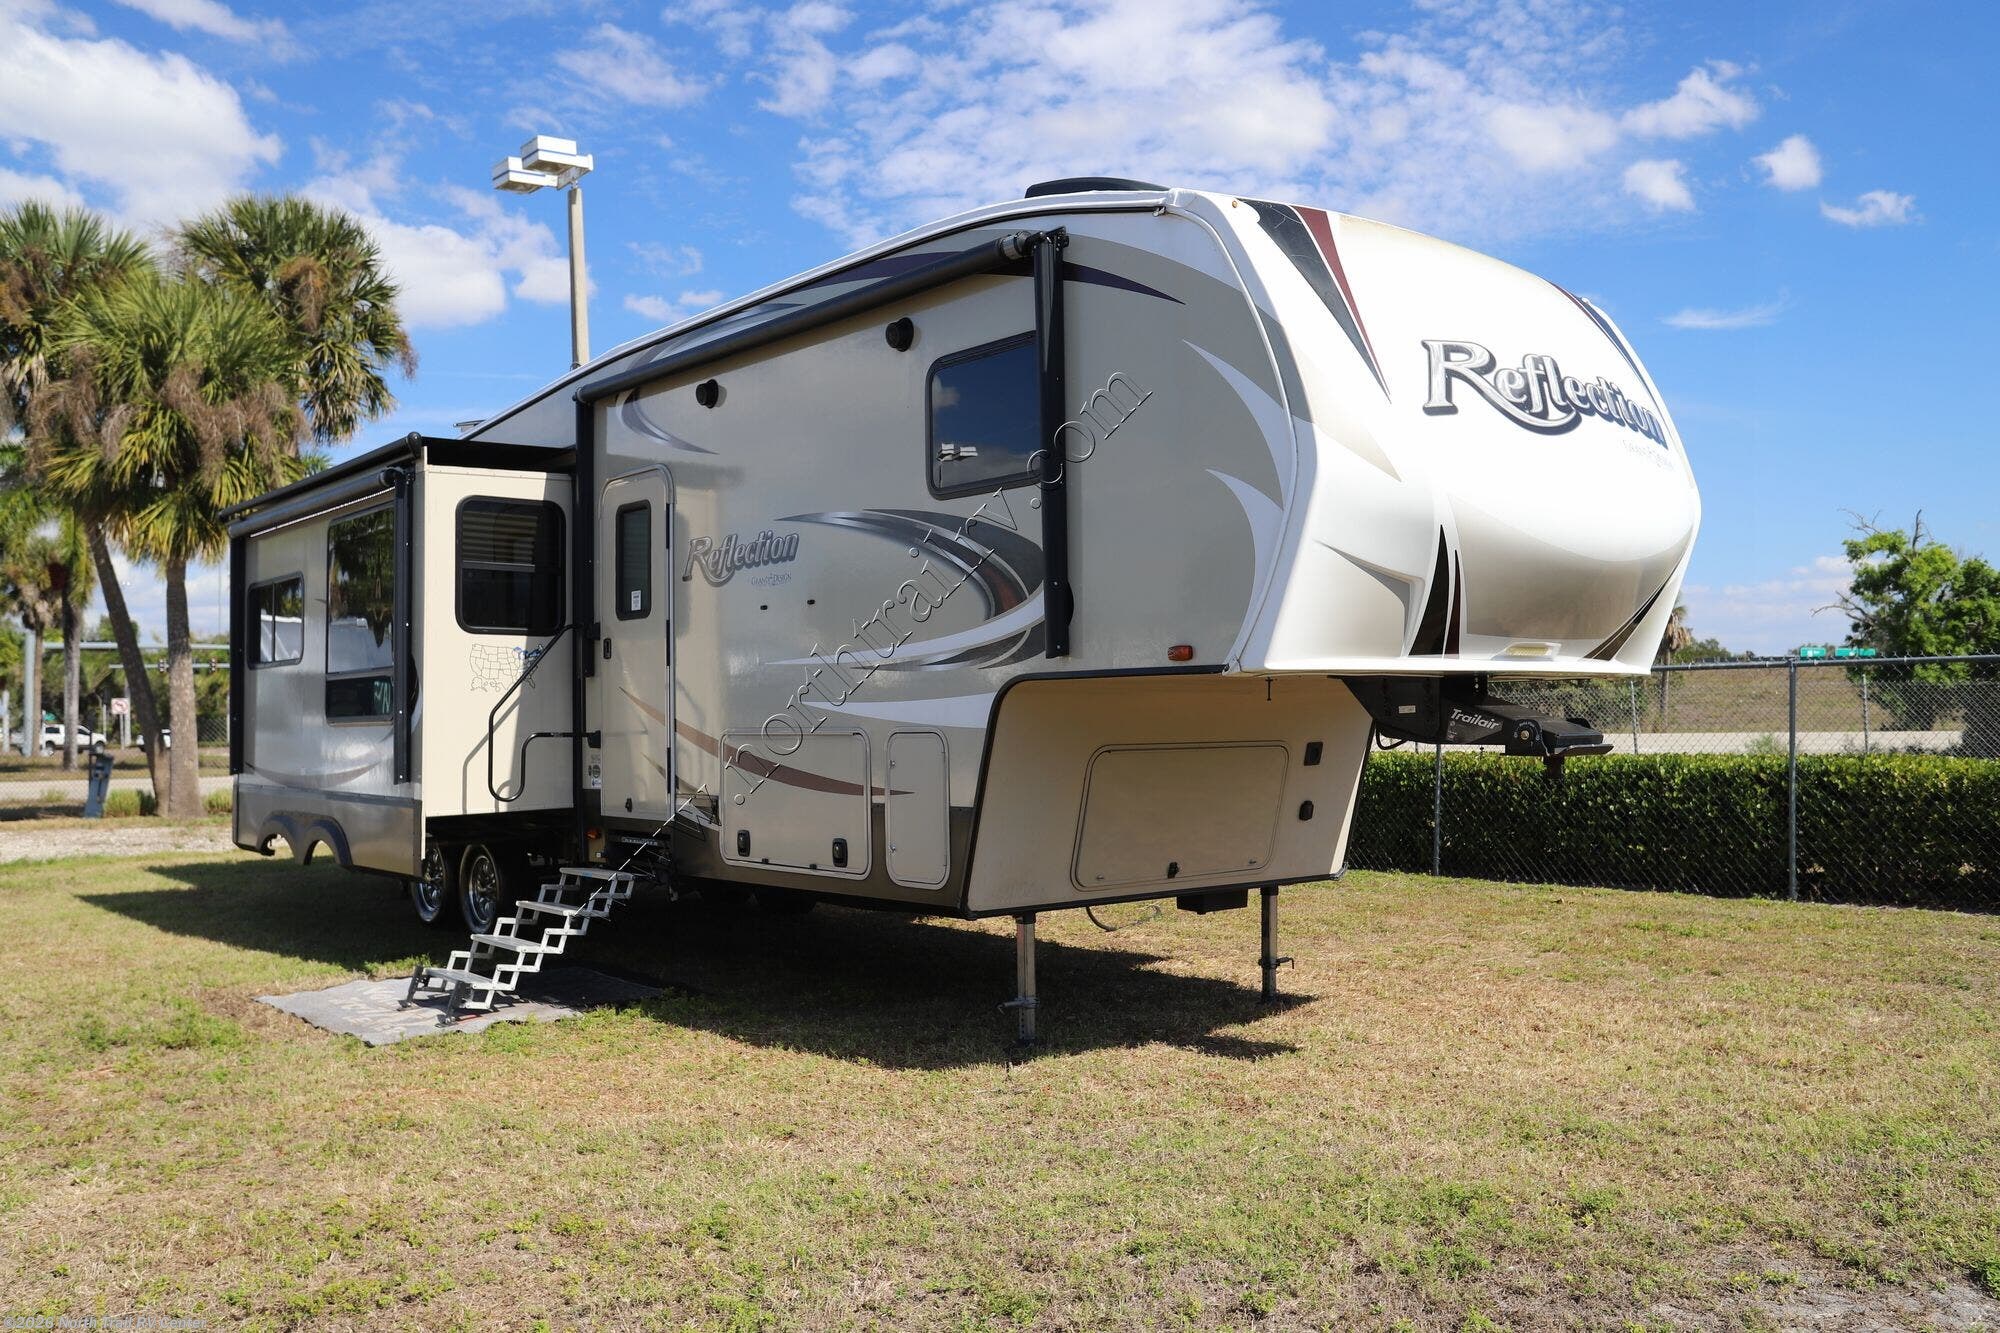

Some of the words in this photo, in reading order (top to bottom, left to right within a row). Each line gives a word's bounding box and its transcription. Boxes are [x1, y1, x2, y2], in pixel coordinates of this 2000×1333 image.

[1421, 339, 1668, 450] Reflection
[682, 530, 799, 587] Reflection
[1450, 708, 1500, 730] Trailair
